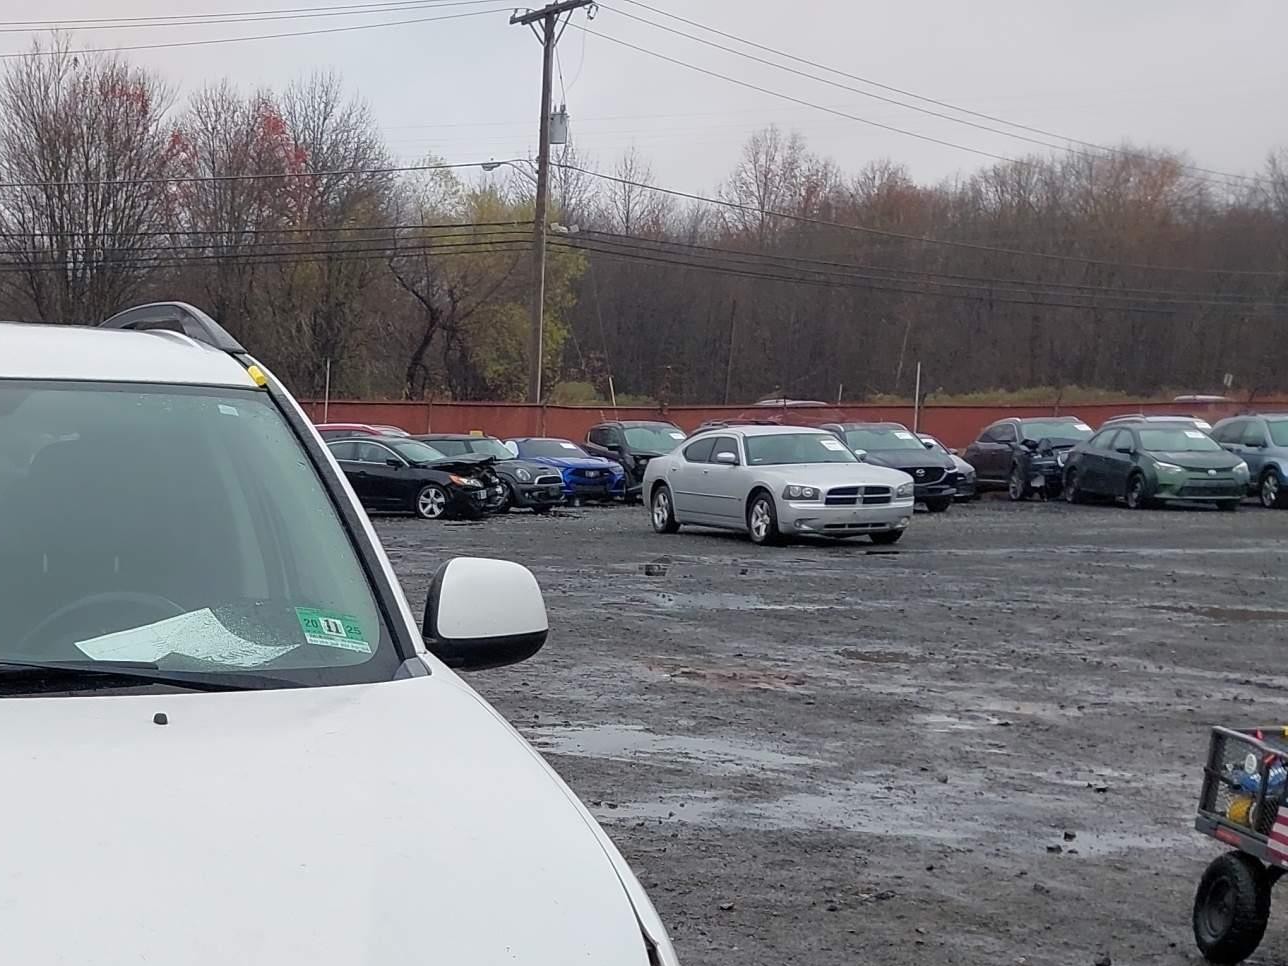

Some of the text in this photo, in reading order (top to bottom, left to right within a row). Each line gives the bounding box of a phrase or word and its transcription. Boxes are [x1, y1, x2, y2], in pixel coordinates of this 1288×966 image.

[304, 618, 319, 629] 20
[324, 619, 342, 634] 11
[346, 625, 362, 635] 25
